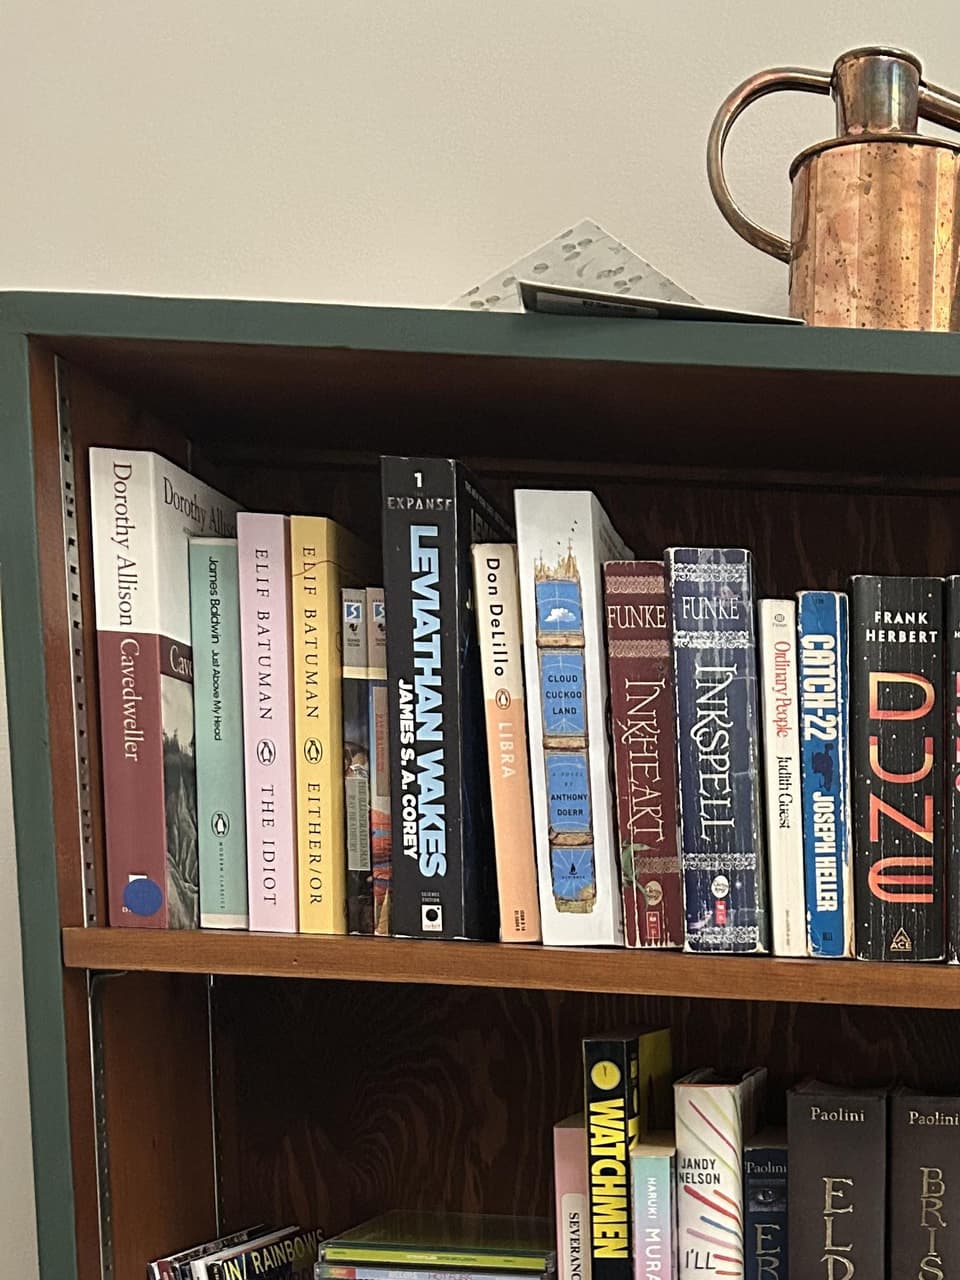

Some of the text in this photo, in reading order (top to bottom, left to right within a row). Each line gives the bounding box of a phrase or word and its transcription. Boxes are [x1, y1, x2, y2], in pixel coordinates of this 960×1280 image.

[163, 477, 206, 532] Dorothy
[111, 462, 145, 763] Dorothy Allison Cavedweller
[208, 557, 222, 644] James Baldwin
[487, 559, 508, 676] Don DeLillo
[607, 604, 667, 629] FUNKE
[682, 596, 740, 620] FUNKE
[875, 611, 929, 625] FRANK
[256, 549, 272, 720] ELIF BATUMAN
[303, 547, 320, 720] ELIF BATUMAN
[865, 629, 939, 643] HERBERT
[410, 525, 447, 878] LEVIATHAN WAKES
[546, 691, 582, 699] CUCKOO
[547, 675, 578, 683] CLOUD
[772, 640, 793, 738] Ordinary People
[802, 634, 839, 741] CATCH-22
[553, 707, 577, 715] LAND
[498, 722, 515, 779] LIBRA
[551, 793, 588, 801] ANTHONY
[557, 808, 584, 817] DOERR
[261, 785, 277, 905] THE IDIOT
[307, 783, 323, 905] EITHER/OR
[813, 791, 839, 912] JOSEPH HELLER
[811, 1107, 864, 1122] Paolini
[908, 1112, 959, 1126] Paolini
[589, 1098, 628, 1258] WATCHMEN
[645, 1178, 658, 1219] HARUKI
[679, 1171, 720, 1185] NELSON
[250, 1229, 324, 1276] RAINBOWS
